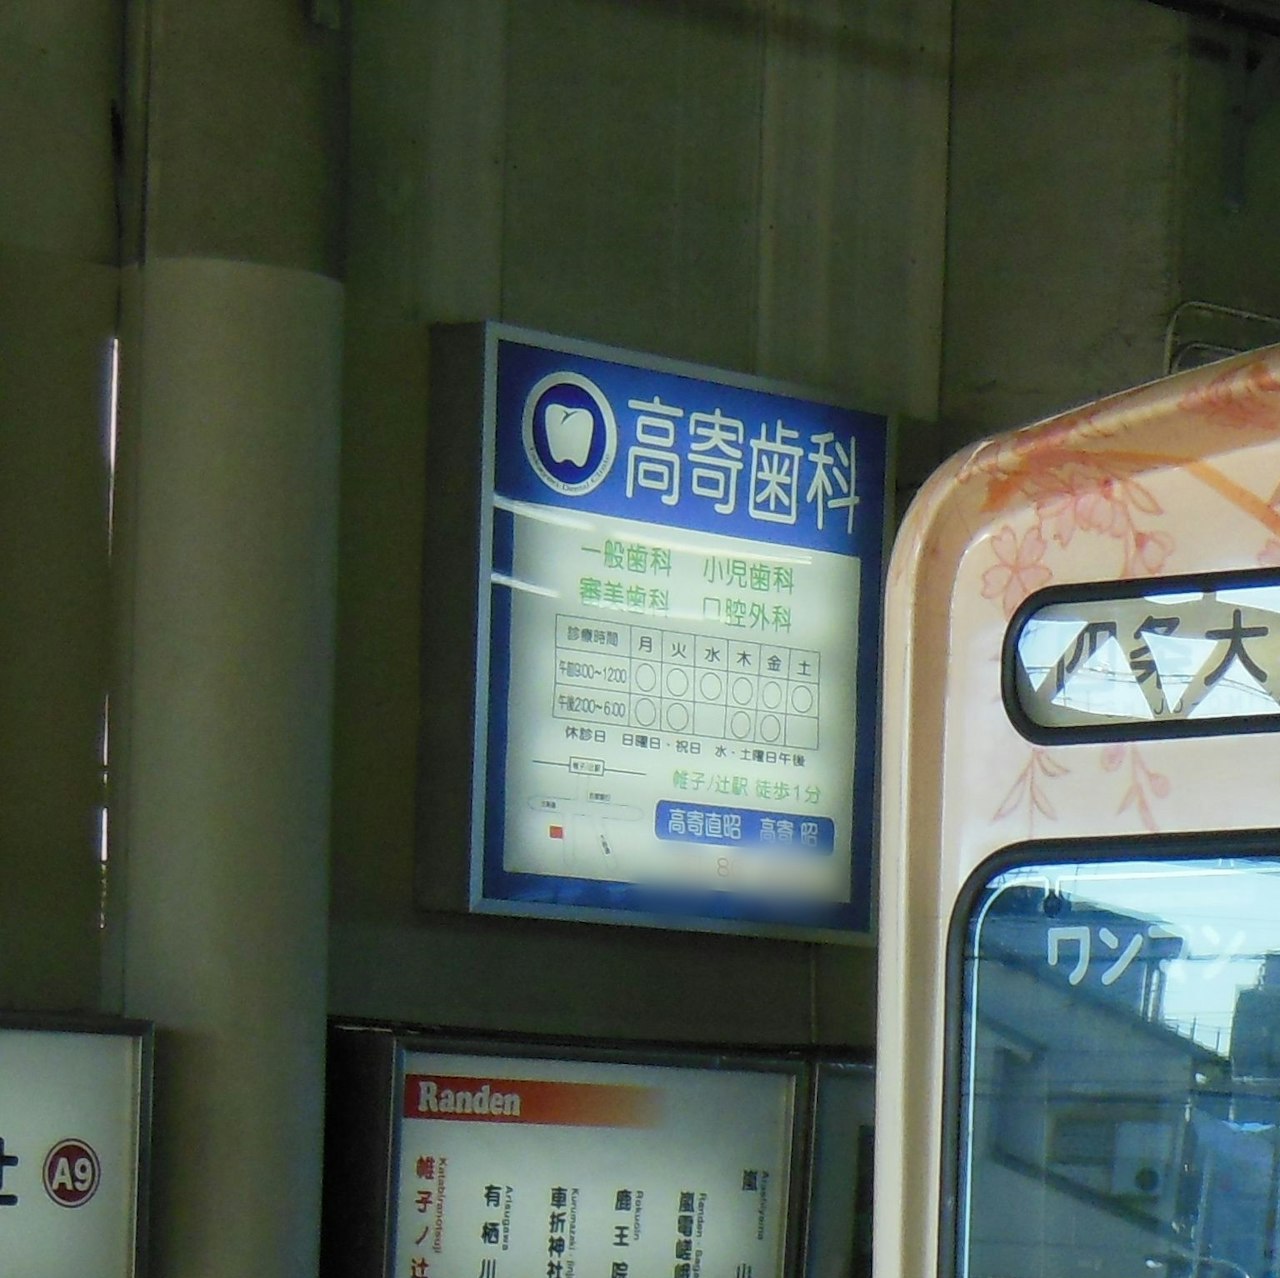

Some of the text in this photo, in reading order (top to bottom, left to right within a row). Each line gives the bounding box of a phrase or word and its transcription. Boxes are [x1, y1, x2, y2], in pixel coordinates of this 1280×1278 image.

[625, 395, 860, 534] 高寄歯科
[581, 539, 794, 595] 一般歯科 小児歯科
[580, 577, 791, 633] 審美歯科 口腔外科
[567, 625, 812, 676] 診療時間 月 火 水 木 金 土
[564, 725, 606, 743] 休診日
[755, 780, 821, 804] 徒歩1分
[668, 808, 742, 840] 高寄直昭
[1047, 926, 1247, 986] ワンマン
[418, 1081, 521, 1117] Randen
[52, 1156, 94, 1192] A9
